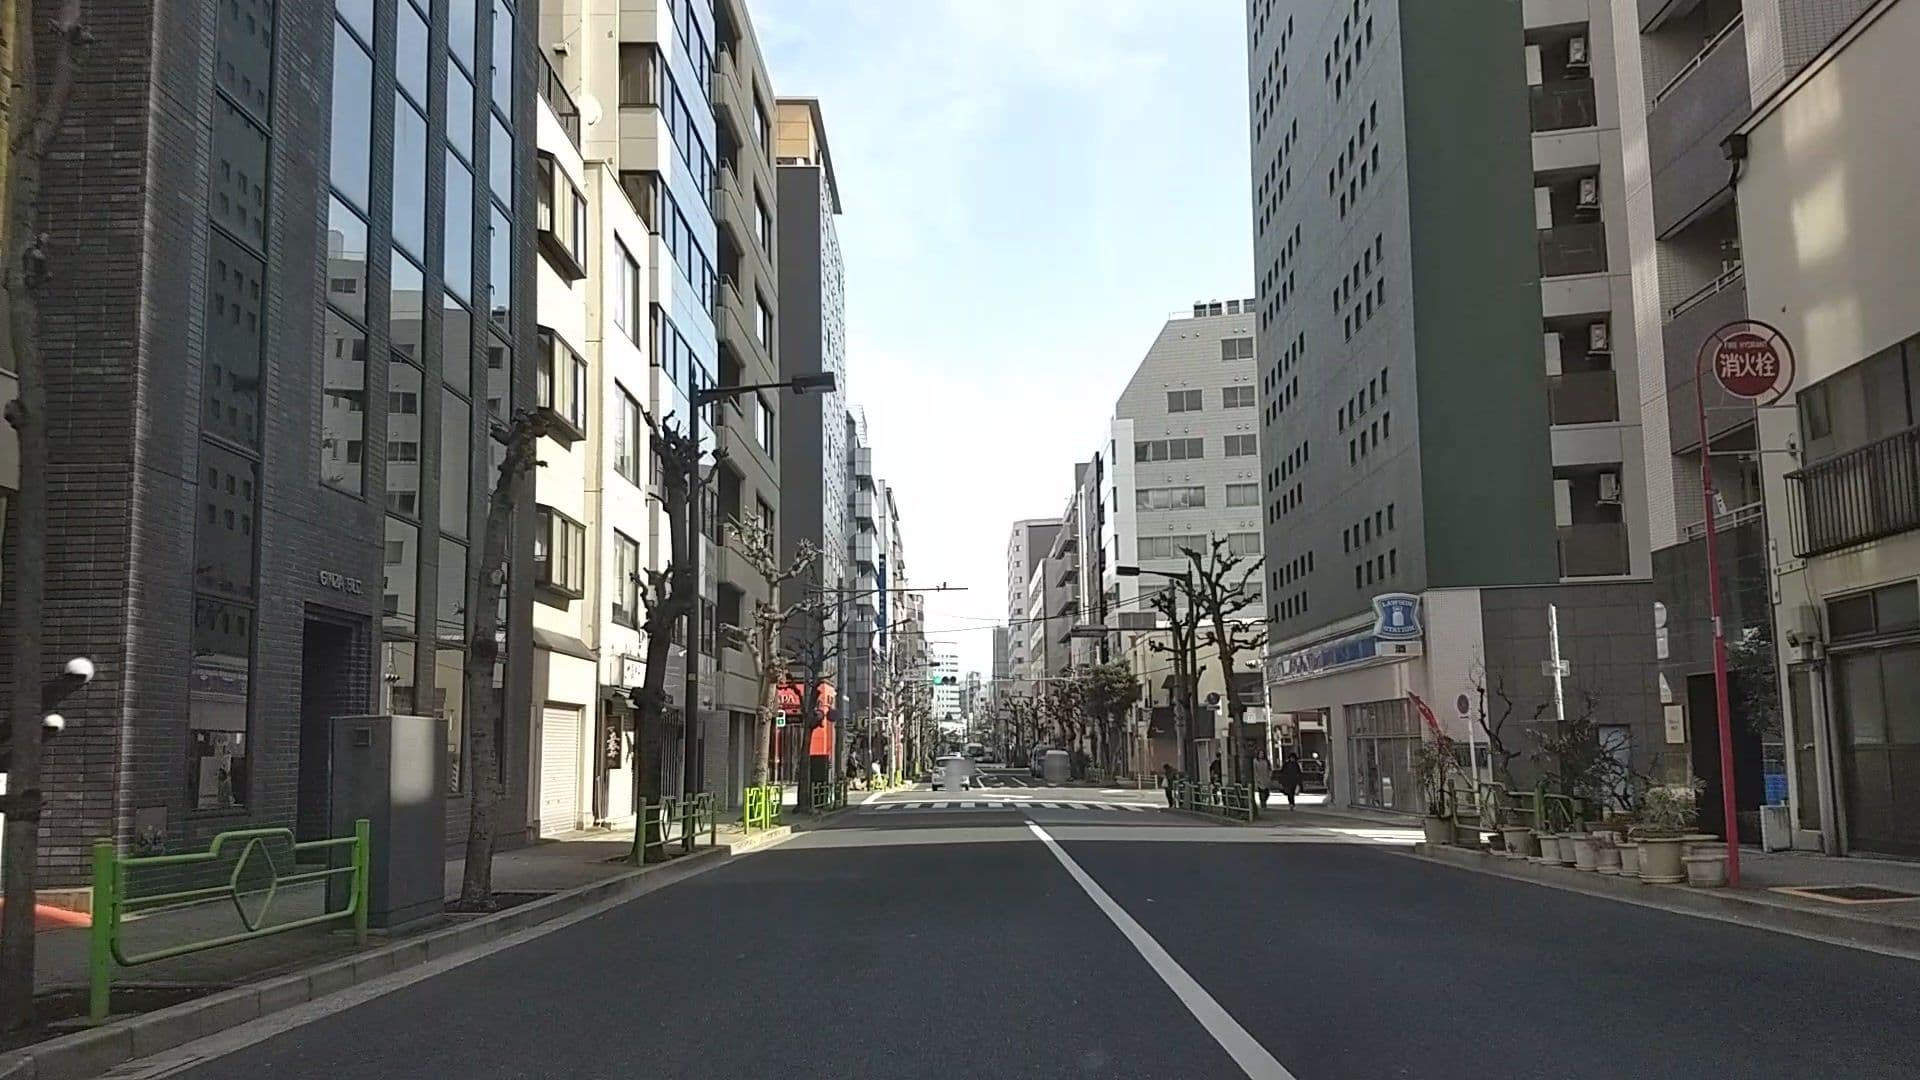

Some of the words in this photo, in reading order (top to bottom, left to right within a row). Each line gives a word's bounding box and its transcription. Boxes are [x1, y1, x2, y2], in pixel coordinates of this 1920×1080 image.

[1719, 351, 1776, 378] 消火栓
[1381, 599, 1414, 607] LAWSON
[1383, 625, 1416, 633] STATION
